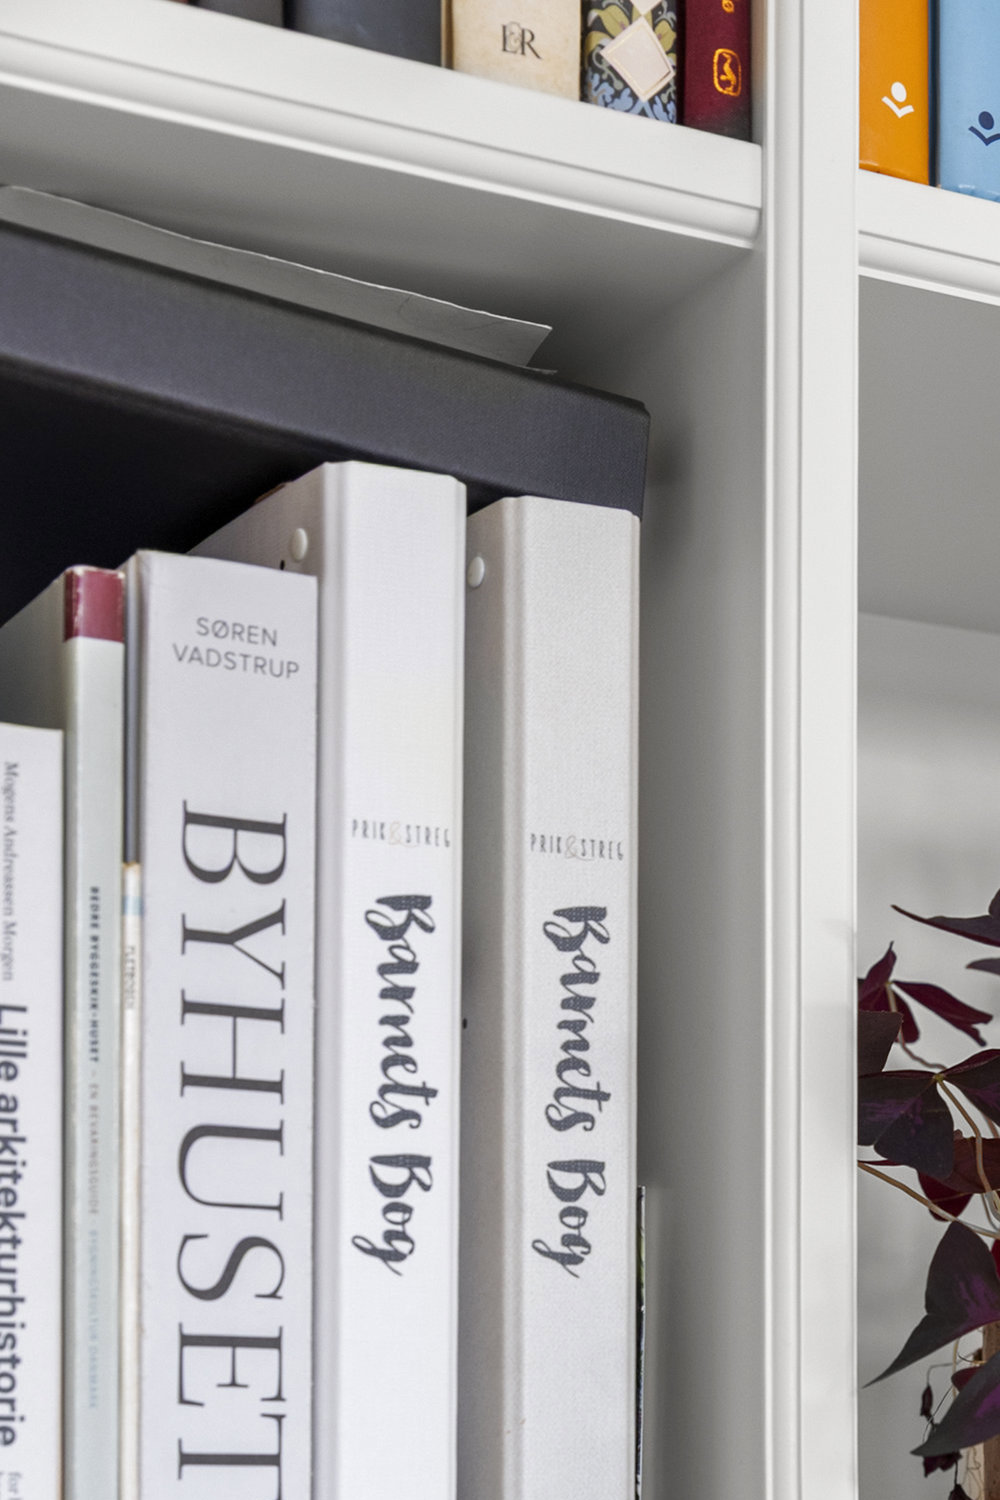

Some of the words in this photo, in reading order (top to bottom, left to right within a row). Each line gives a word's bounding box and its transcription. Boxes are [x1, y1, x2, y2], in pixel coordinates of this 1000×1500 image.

[172, 642, 300, 680] VADSTRUP
[195, 616, 278, 648] SØREN
[0, 1004, 28, 1082] Lille
[364, 894, 439, 1130] Barnets
[543, 905, 612, 1132] Barnets
[0, 1093, 27, 1447] arkitekturhistorie
[351, 1153, 433, 1277] Bog
[532, 1159, 607, 1279] Bog
